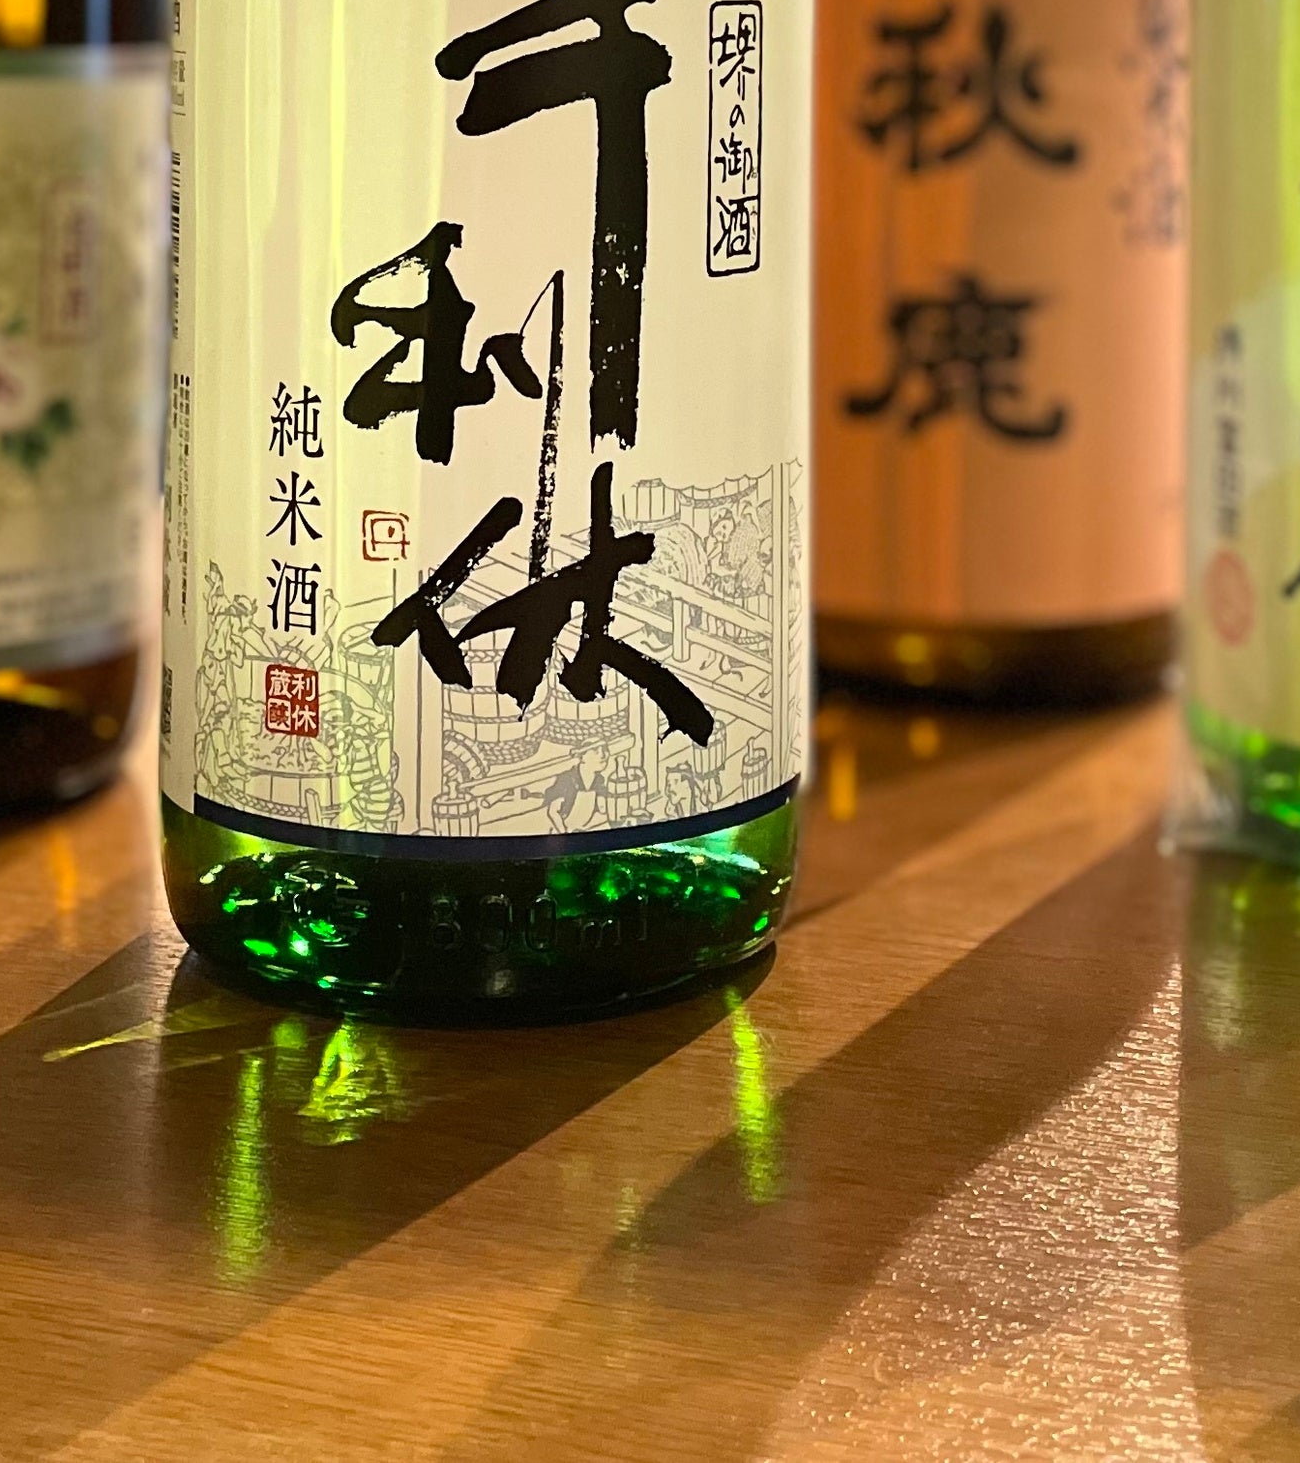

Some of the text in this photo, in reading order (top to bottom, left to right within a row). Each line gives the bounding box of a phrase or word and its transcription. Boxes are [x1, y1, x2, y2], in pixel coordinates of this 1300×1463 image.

[842, 0, 1080, 443] 秋鹿
[266, 381, 324, 636] 純米酒
